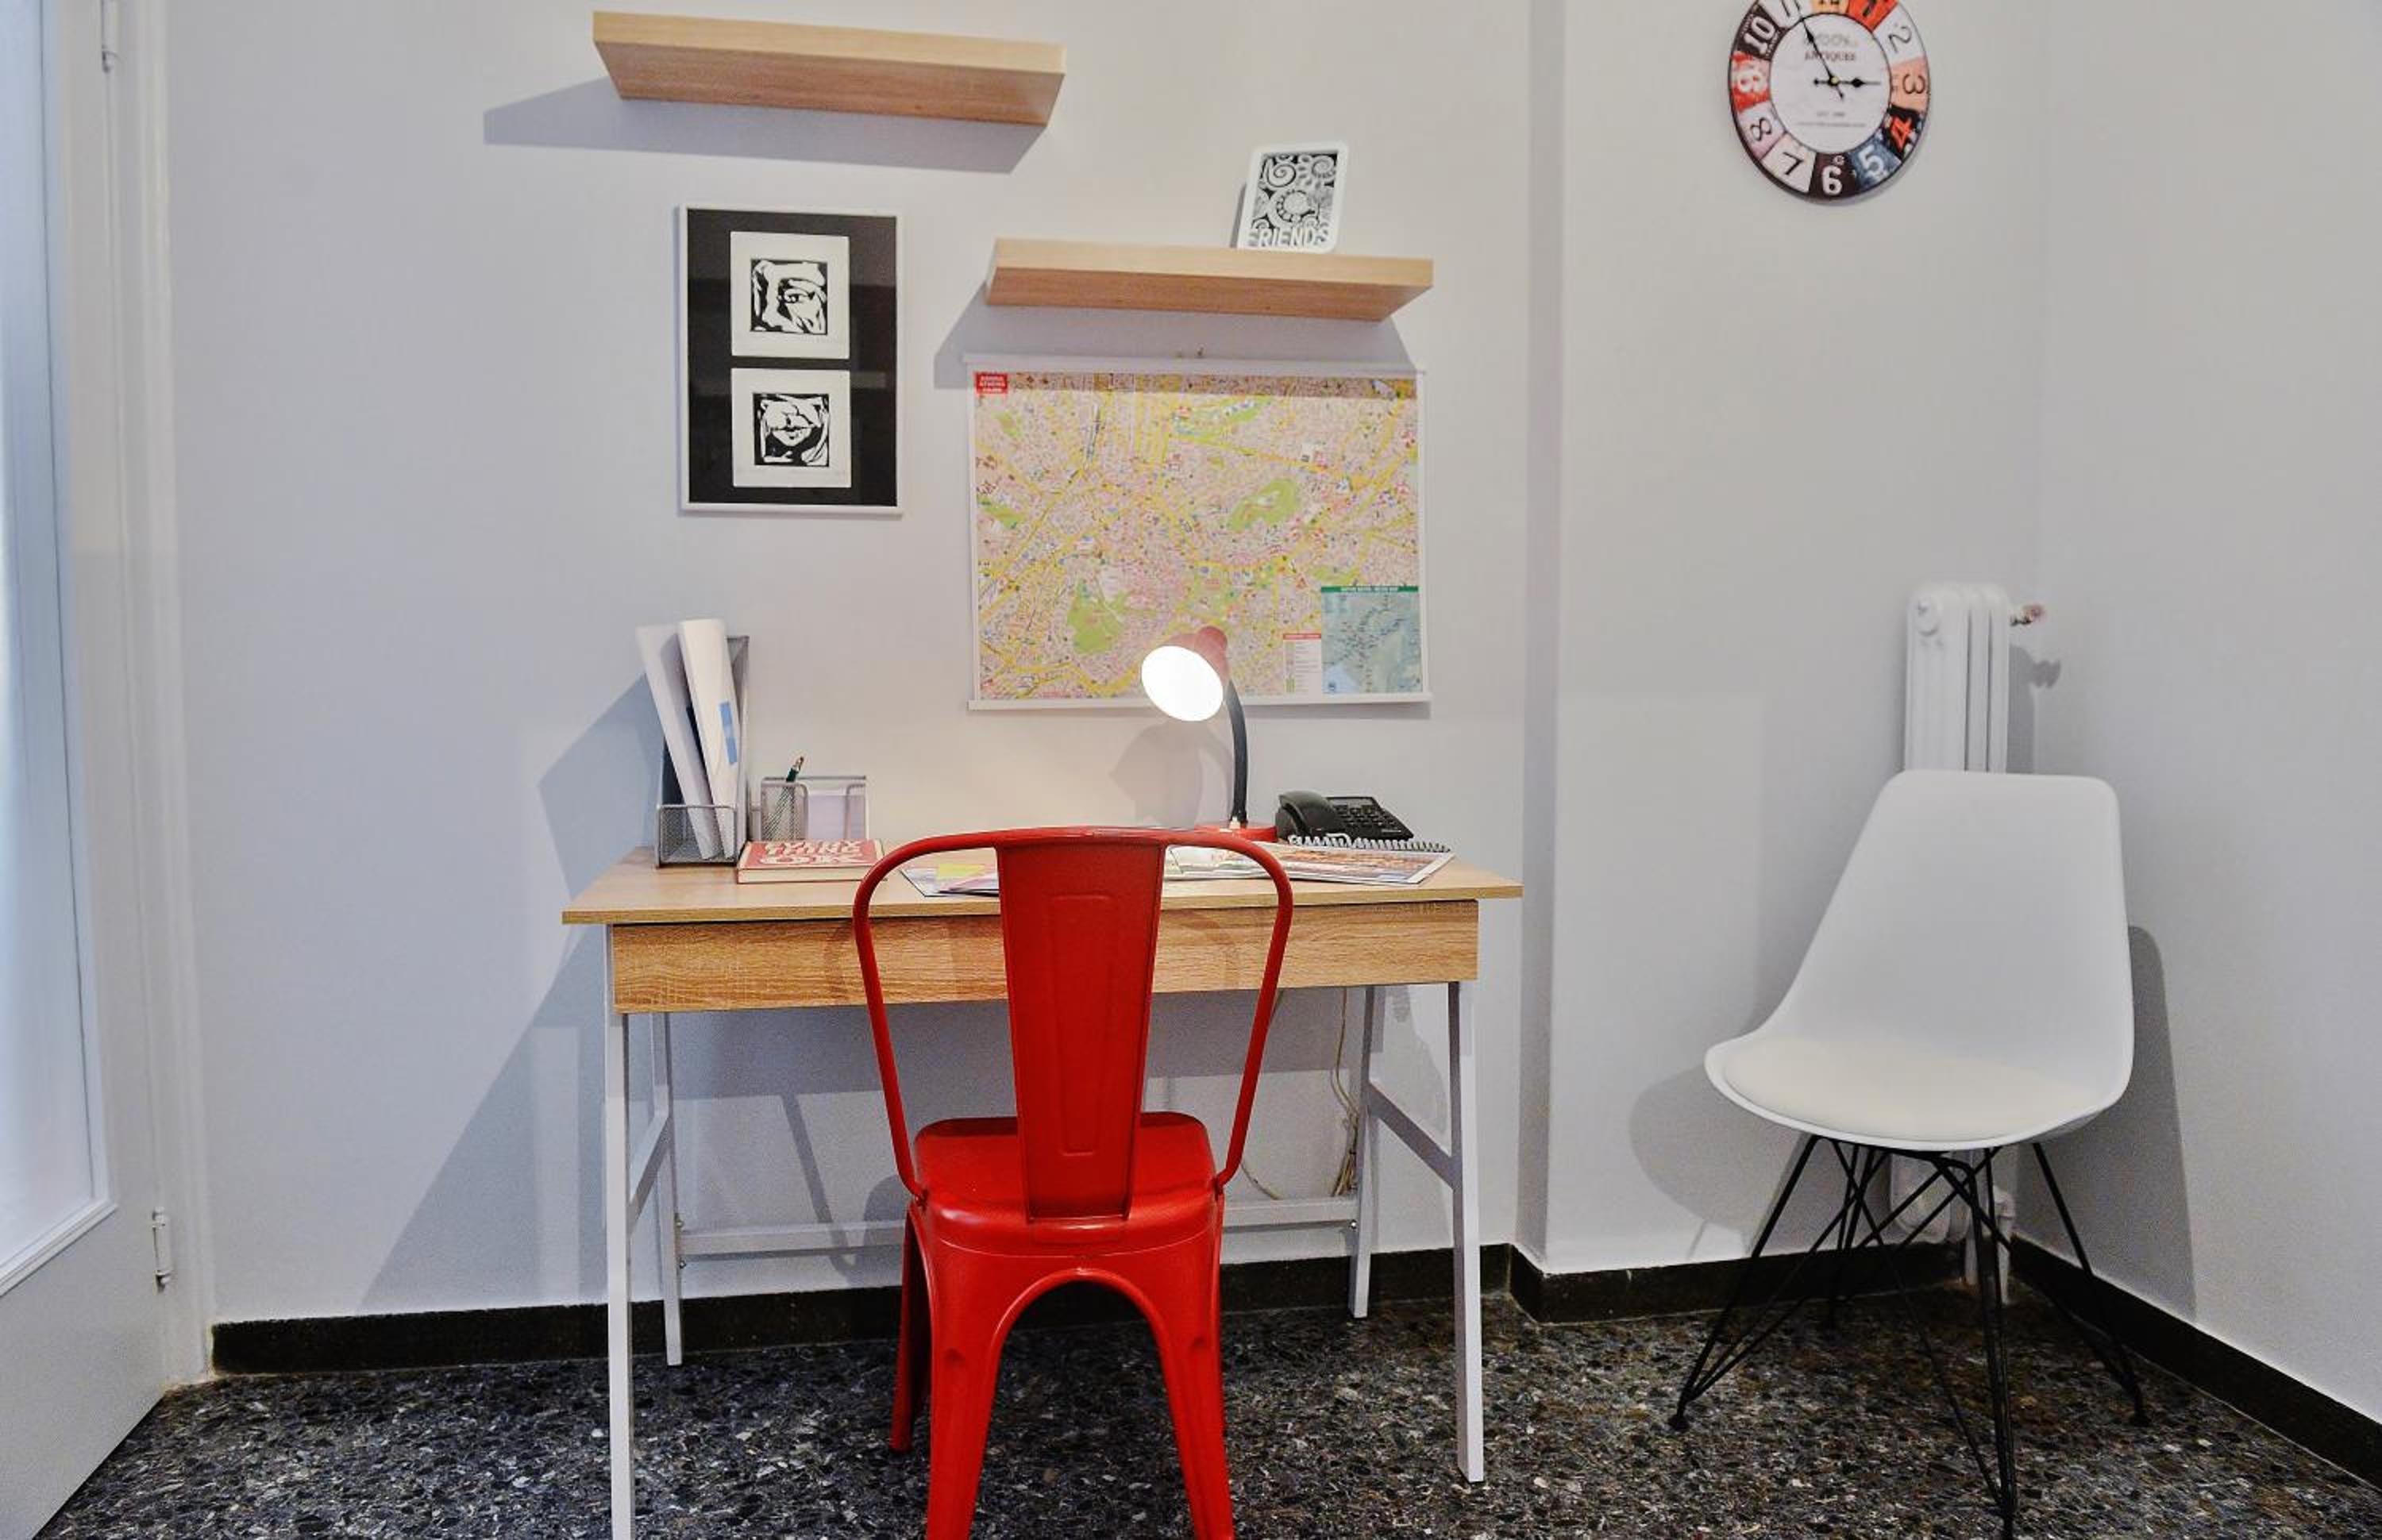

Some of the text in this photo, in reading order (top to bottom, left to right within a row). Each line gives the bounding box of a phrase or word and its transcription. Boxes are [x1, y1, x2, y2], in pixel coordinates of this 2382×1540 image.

[1744, 16, 1775, 54] 10
[1888, 25, 1912, 53] 2
[1902, 74, 1926, 95] 3
[1749, 117, 1772, 142] 8
[1891, 115, 1912, 152] 4
[1783, 152, 1804, 176] 7
[1859, 144, 1884, 174] 5
[1821, 165, 1843, 195] 6
[1245, 221, 1329, 247] FRIENDS
